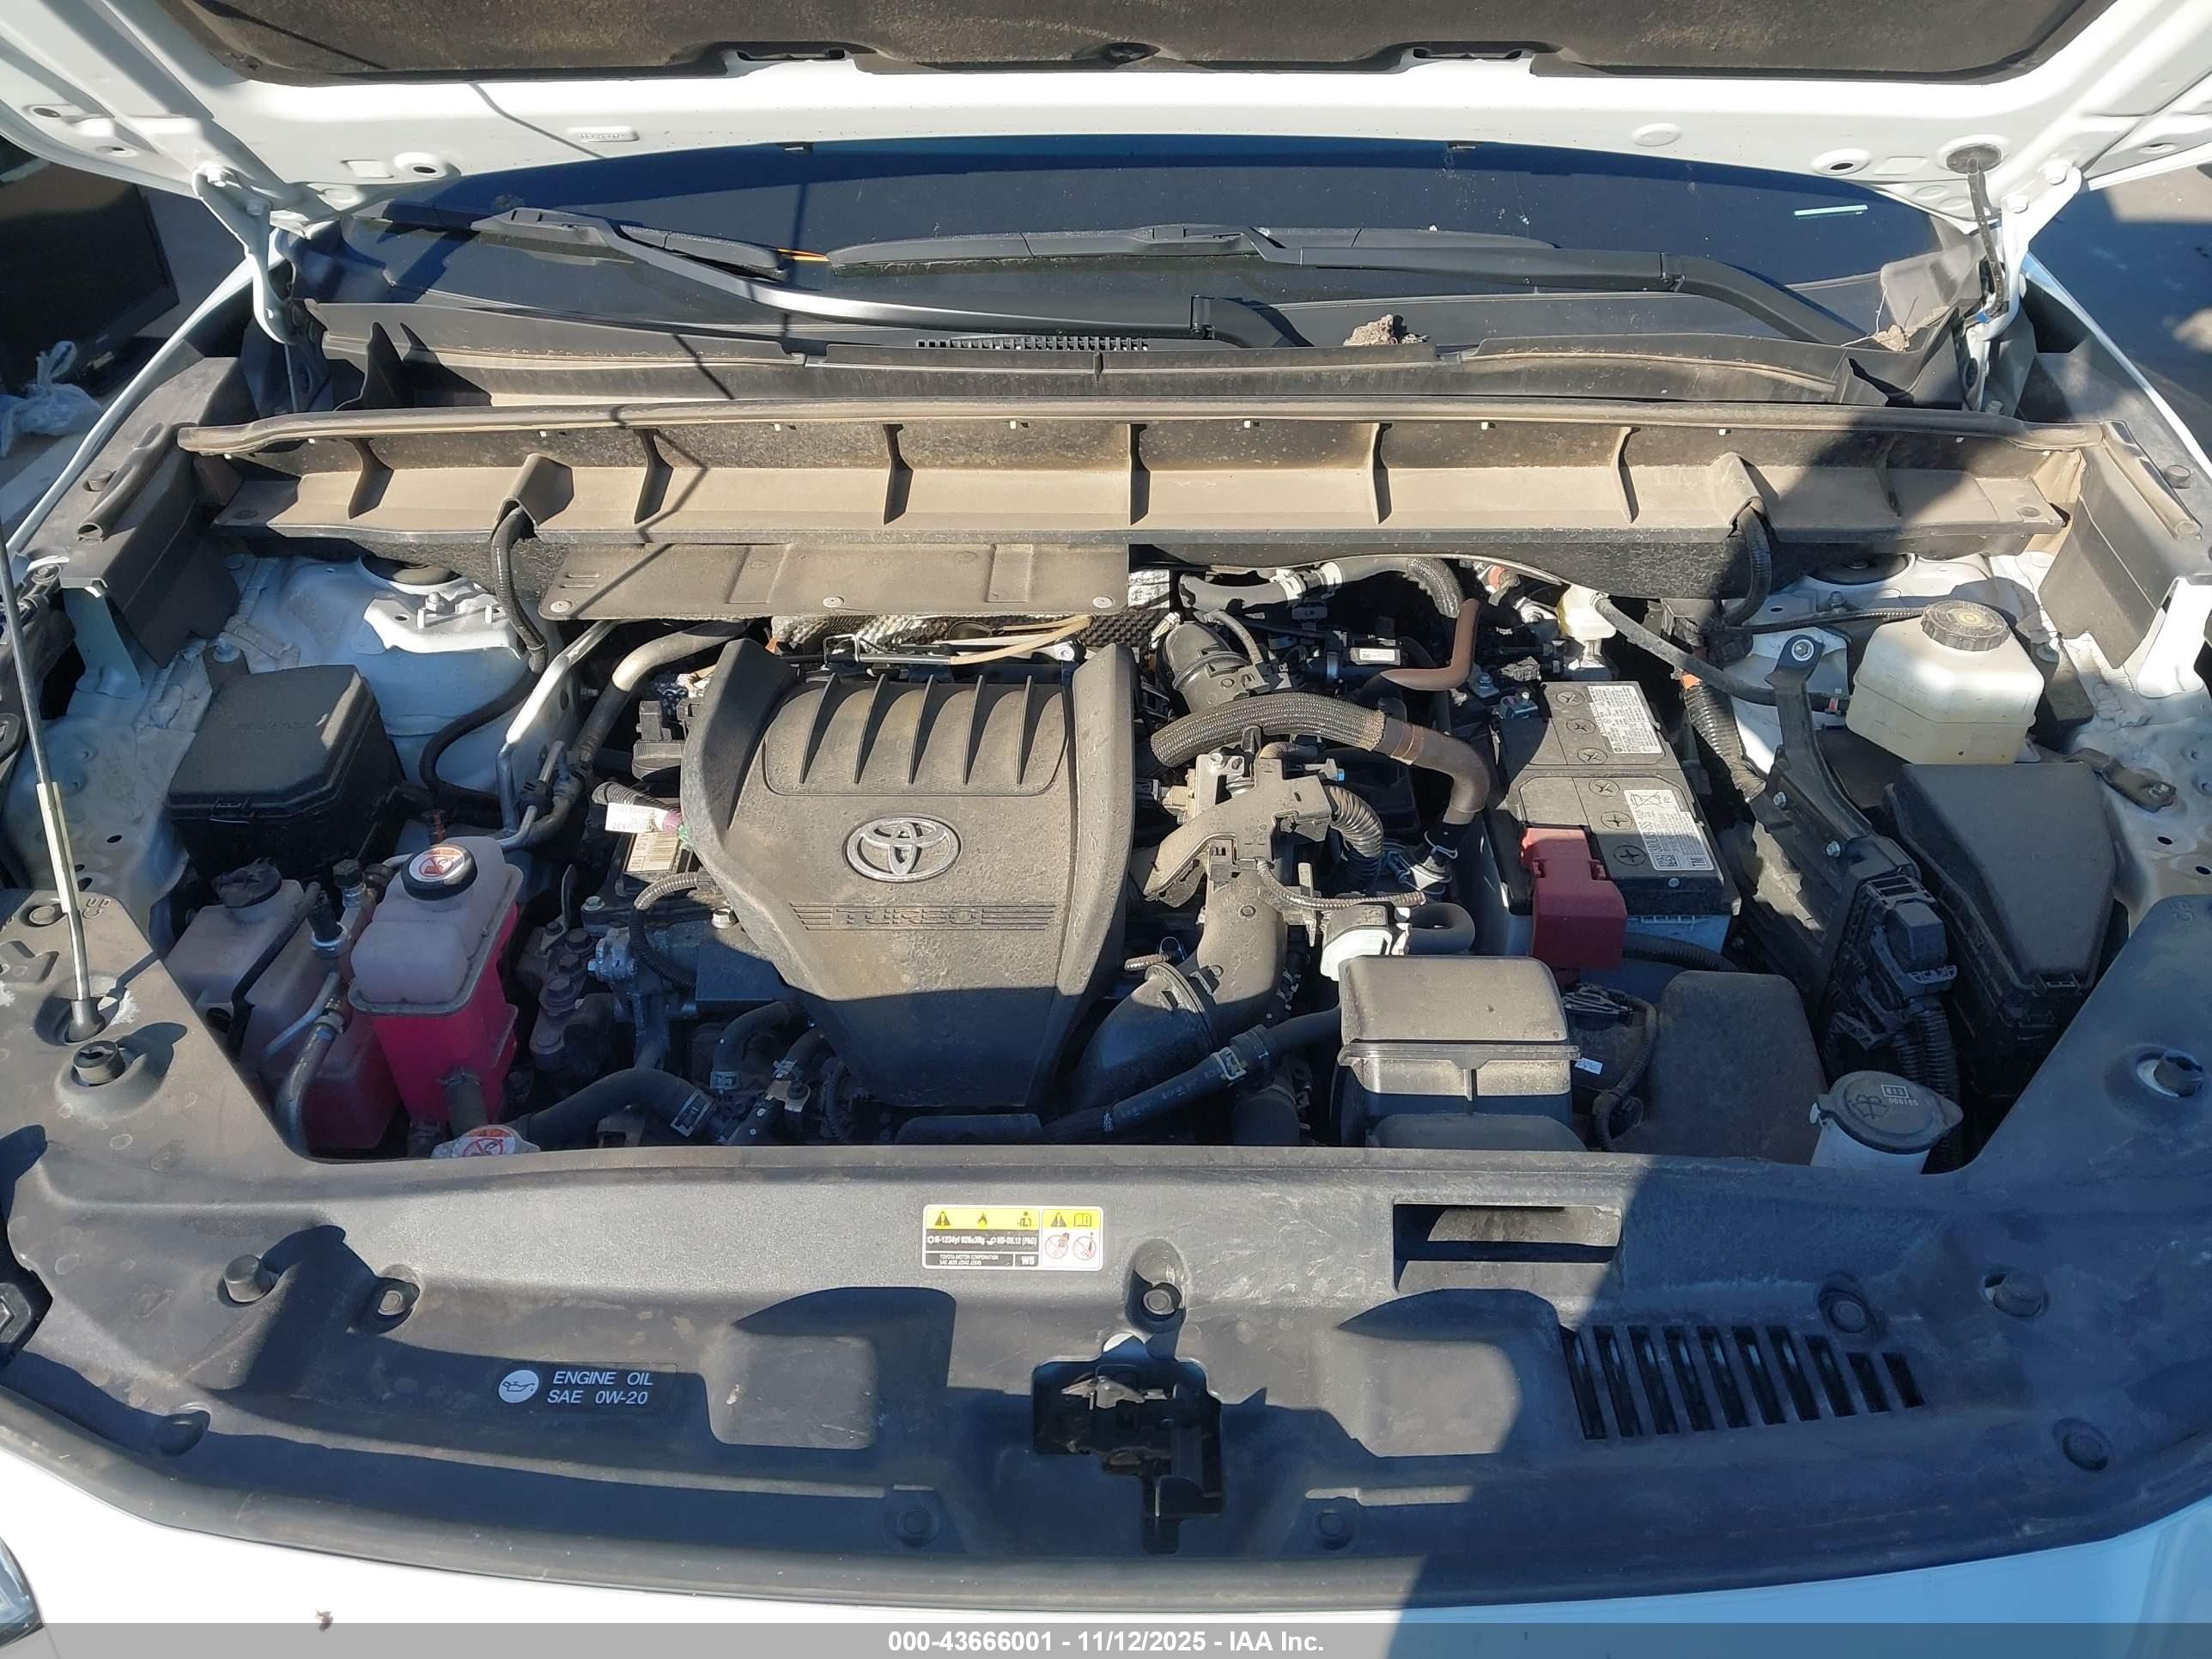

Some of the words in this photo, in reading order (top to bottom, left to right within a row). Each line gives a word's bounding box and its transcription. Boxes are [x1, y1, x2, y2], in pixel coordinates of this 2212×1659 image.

[836, 907, 977, 926] TURBO
[552, 1370, 617, 1385] ENGINE
[627, 1371, 653, 1386] OIL
[547, 1389, 584, 1403] SAE
[595, 1390, 648, 1405] 0W-20
